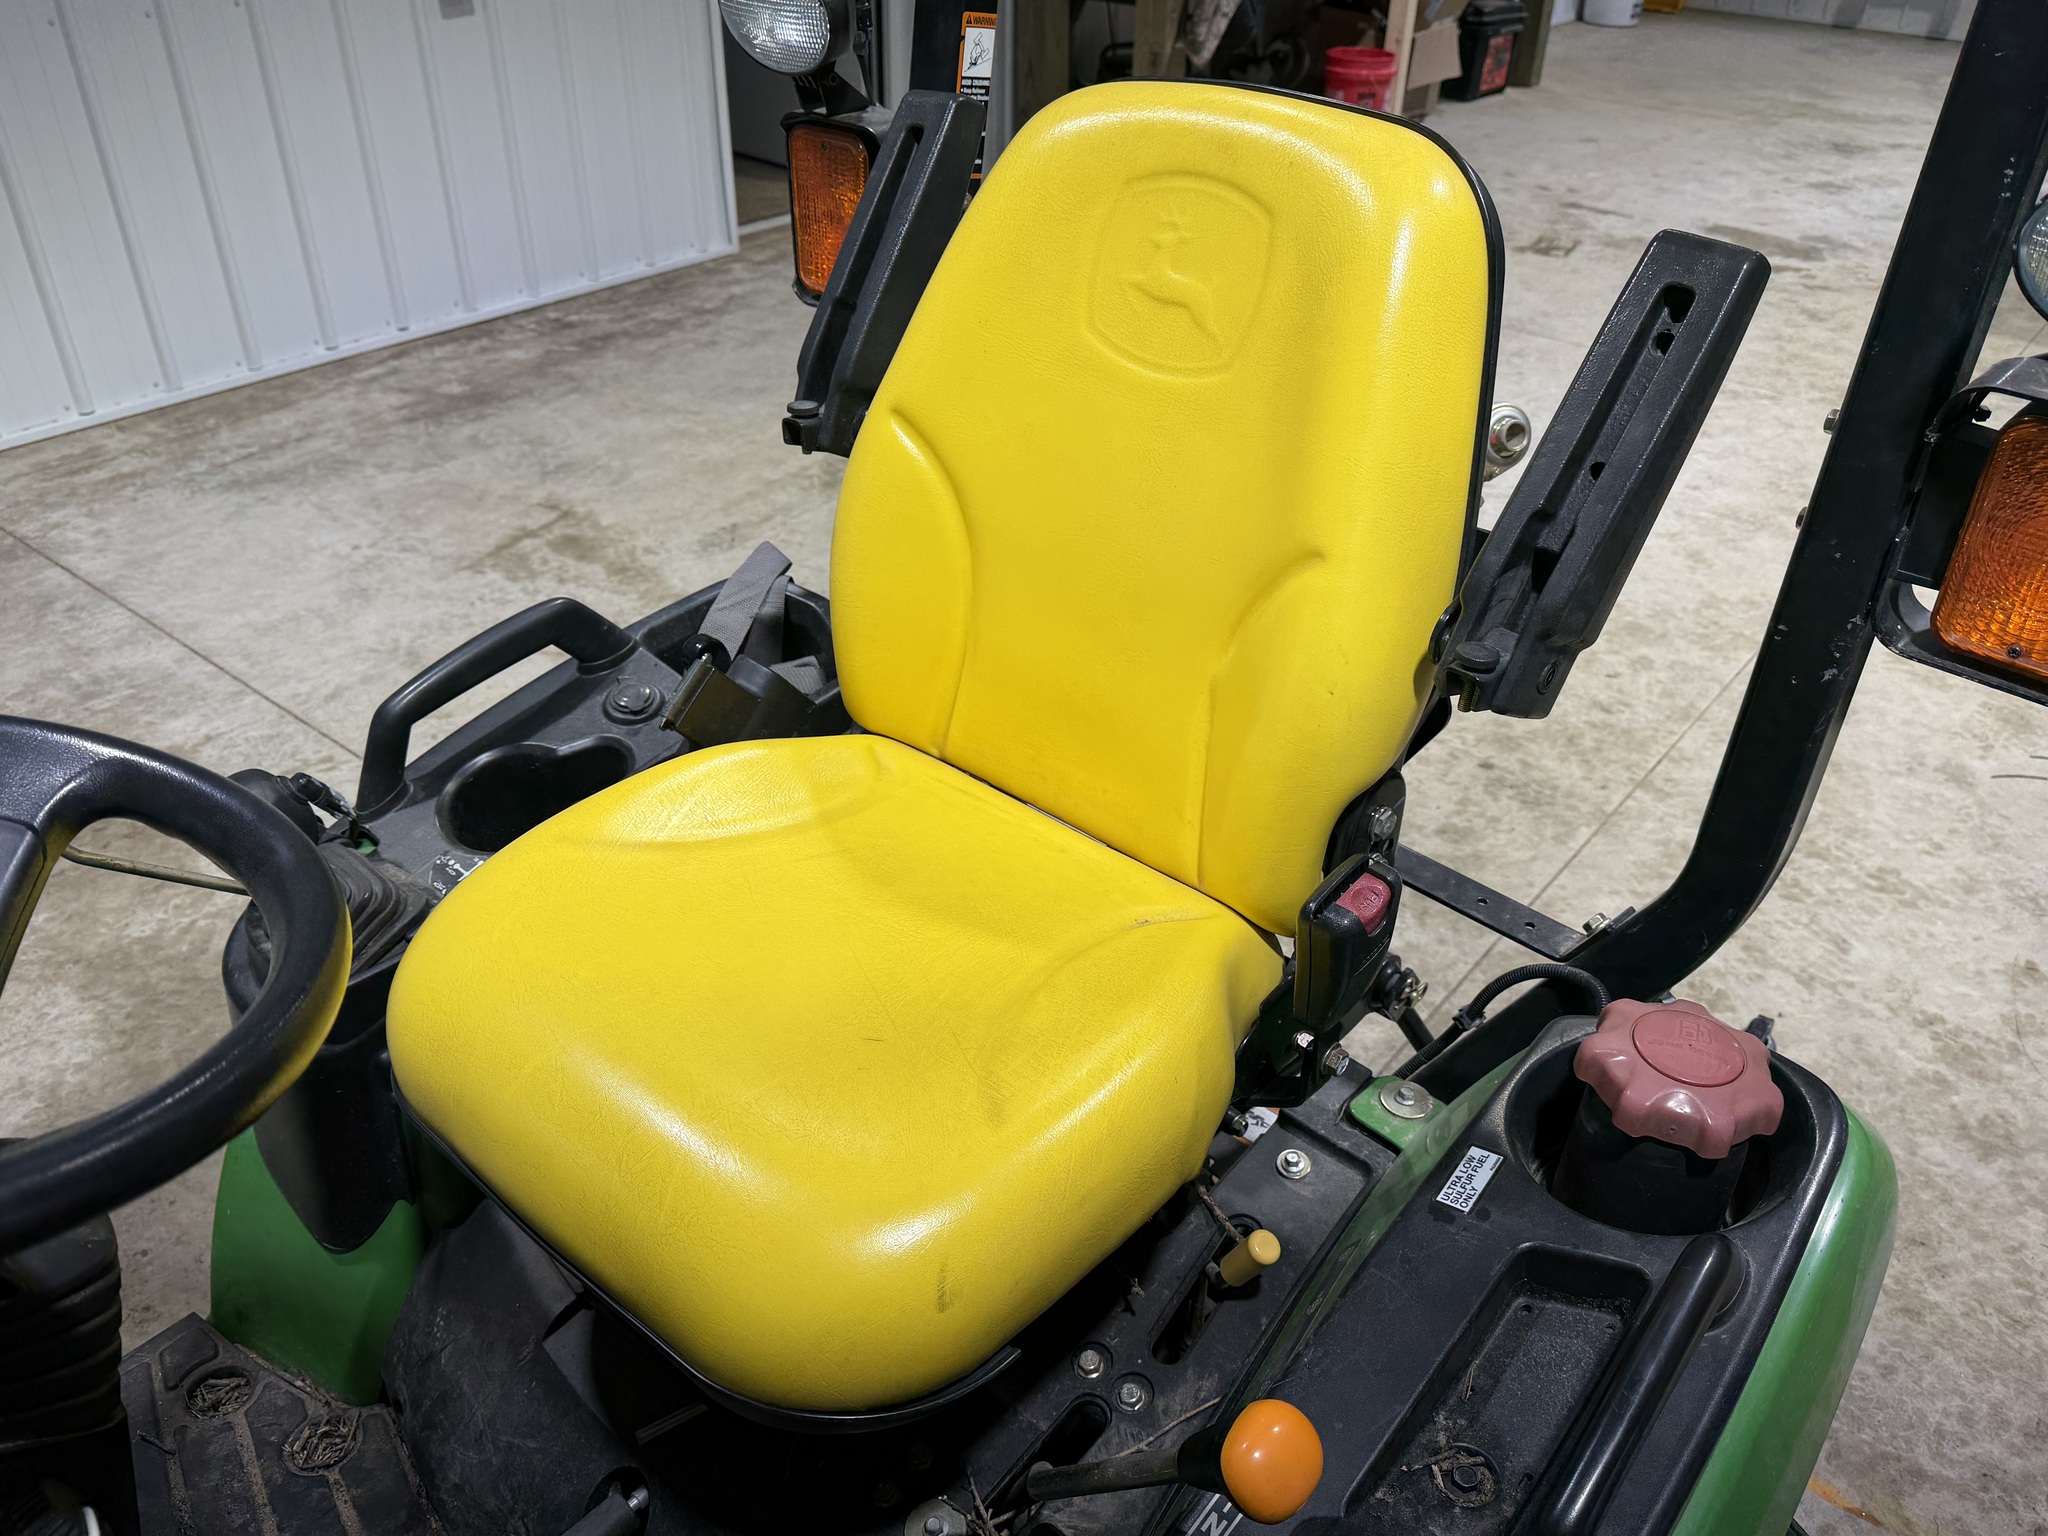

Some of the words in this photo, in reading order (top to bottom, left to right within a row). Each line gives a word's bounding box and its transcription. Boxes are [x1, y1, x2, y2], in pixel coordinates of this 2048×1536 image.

[1440, 1175, 1464, 1201] ULTRA
[1459, 1154, 1477, 1174] LOW
[1450, 1174, 1476, 1205] SULFUR
[1471, 1154, 1491, 1173] FUEL
[1459, 1185, 1478, 1208] ONLY
[1200, 1511, 1228, 1536] N
